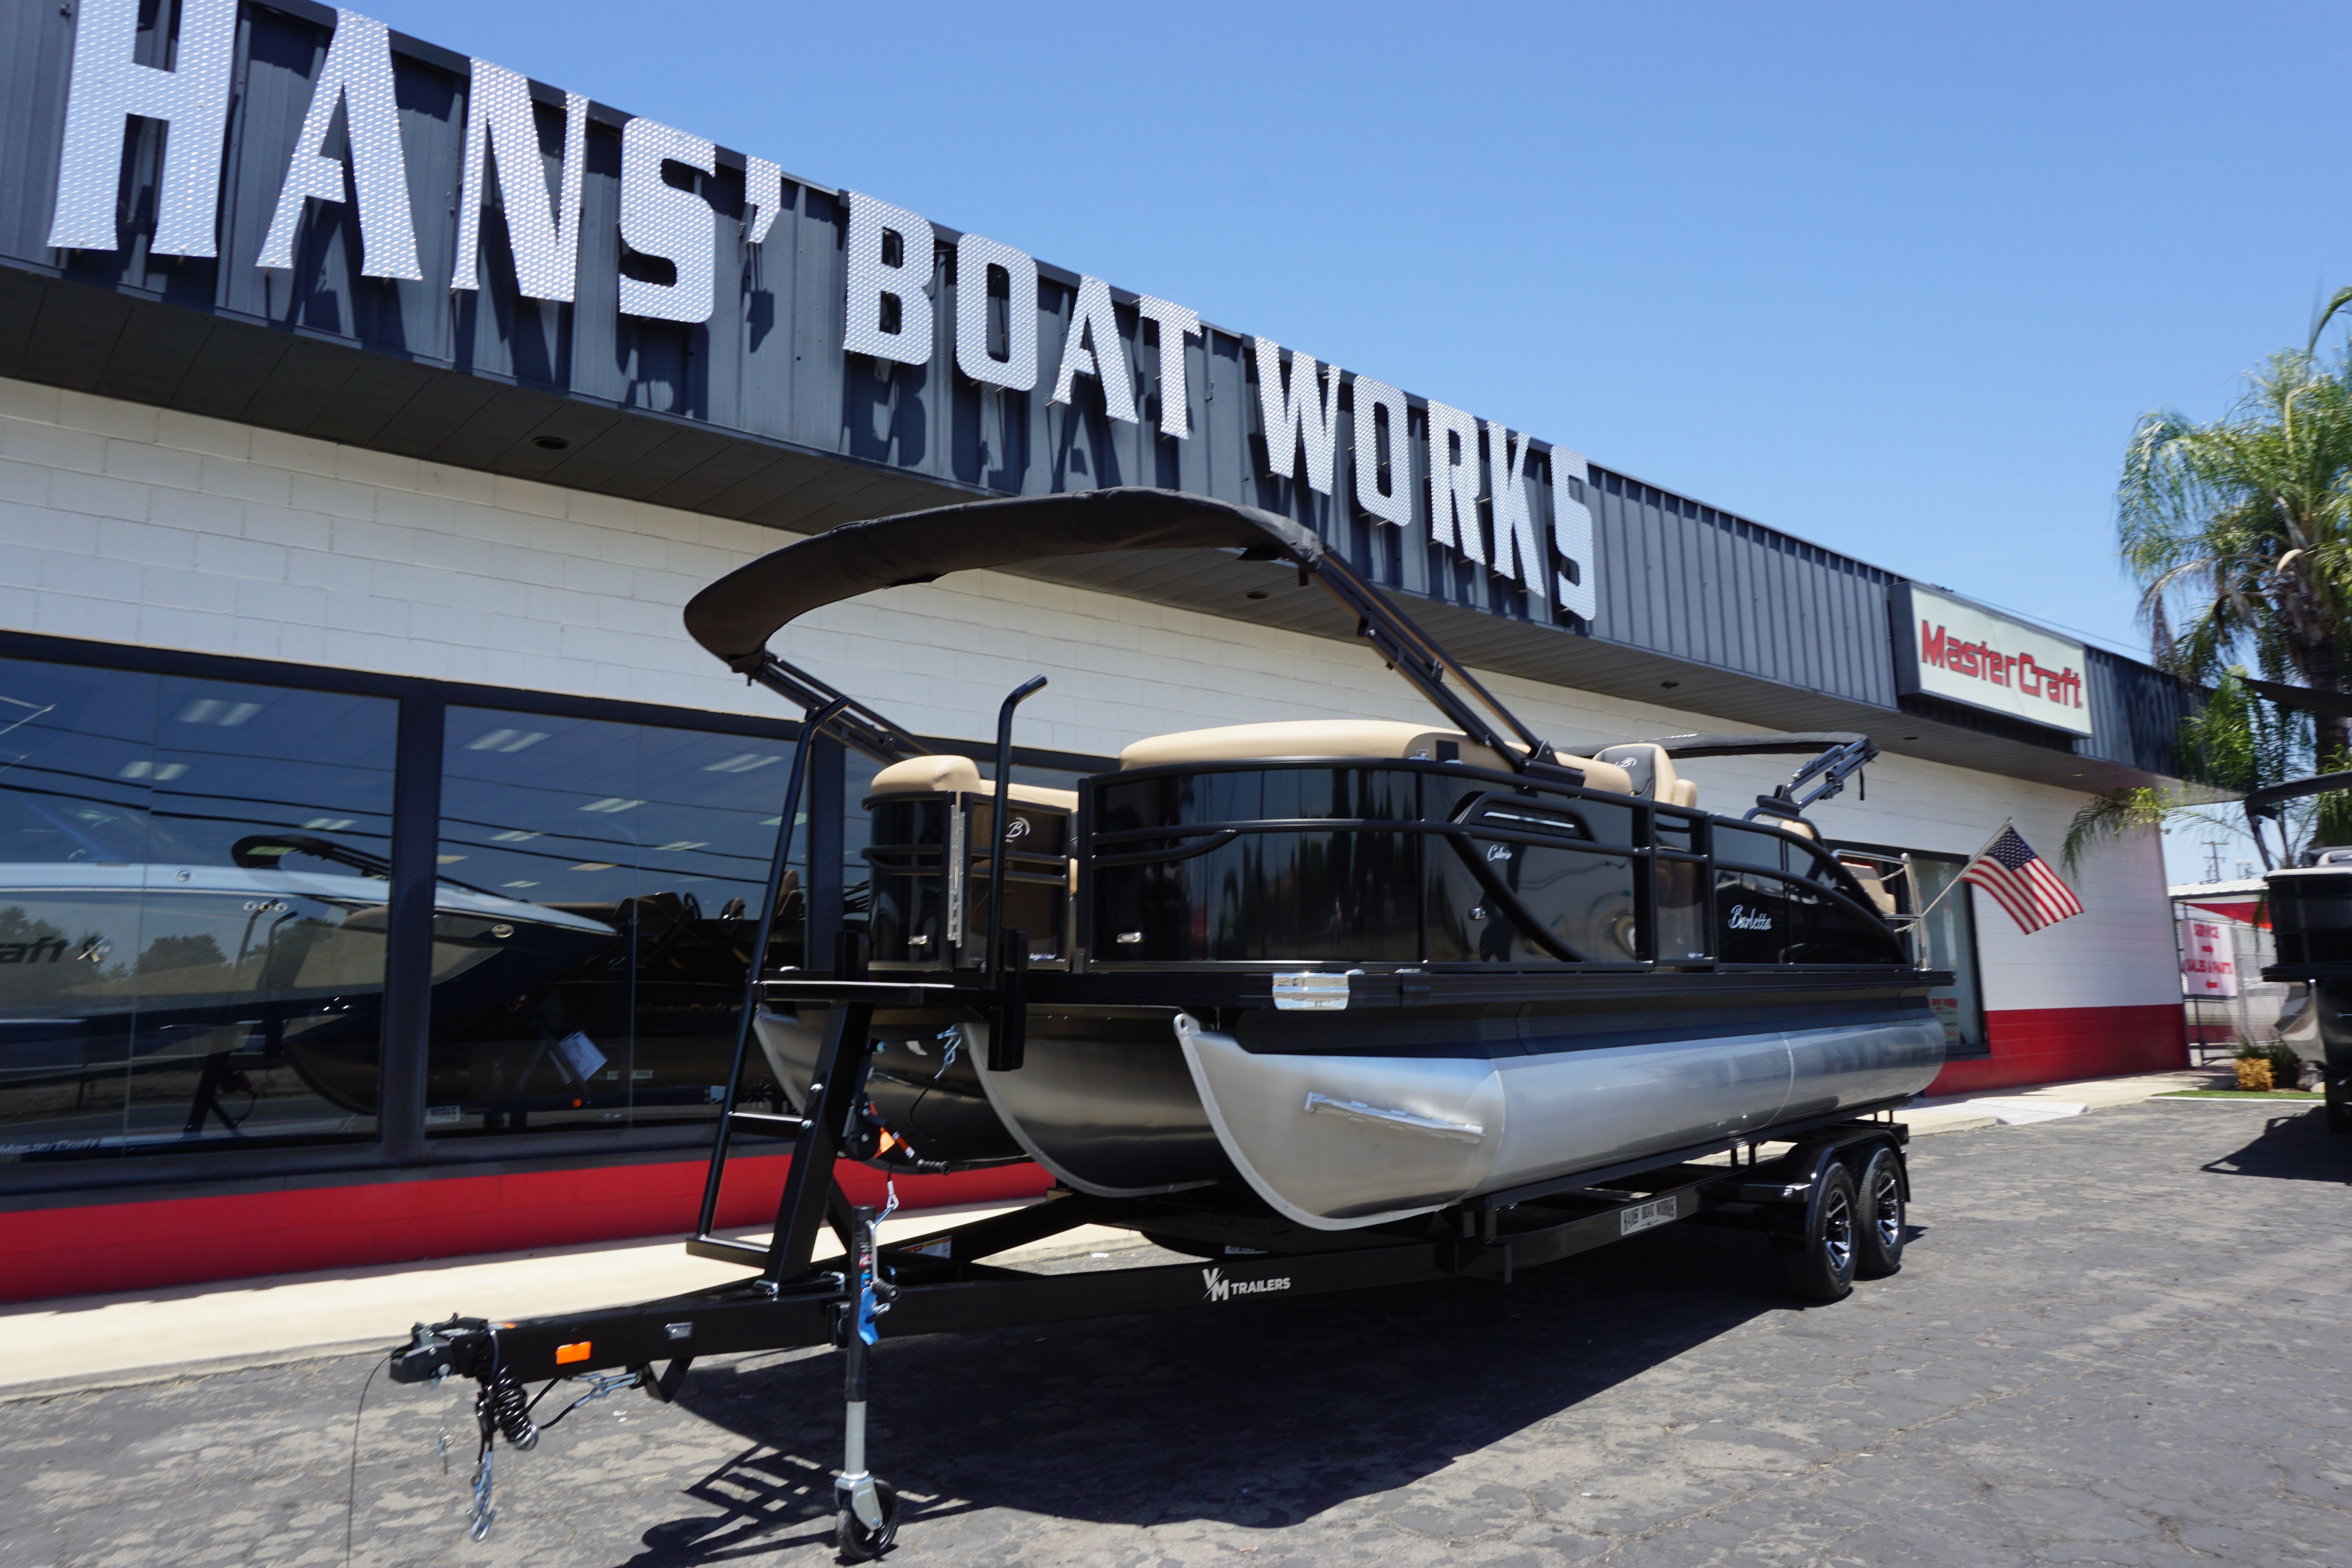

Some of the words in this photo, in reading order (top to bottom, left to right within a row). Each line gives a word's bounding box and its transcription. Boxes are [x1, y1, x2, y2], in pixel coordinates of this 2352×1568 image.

[843, 189, 1202, 440] BOAT
[1254, 335, 1596, 621] WORKS
[1922, 619, 2081, 709] MasterCraft
[1728, 904, 1773, 931] Barletta
[2194, 924, 2219, 939] SERVICE
[1230, 1277, 1291, 1295] TRAILERS
